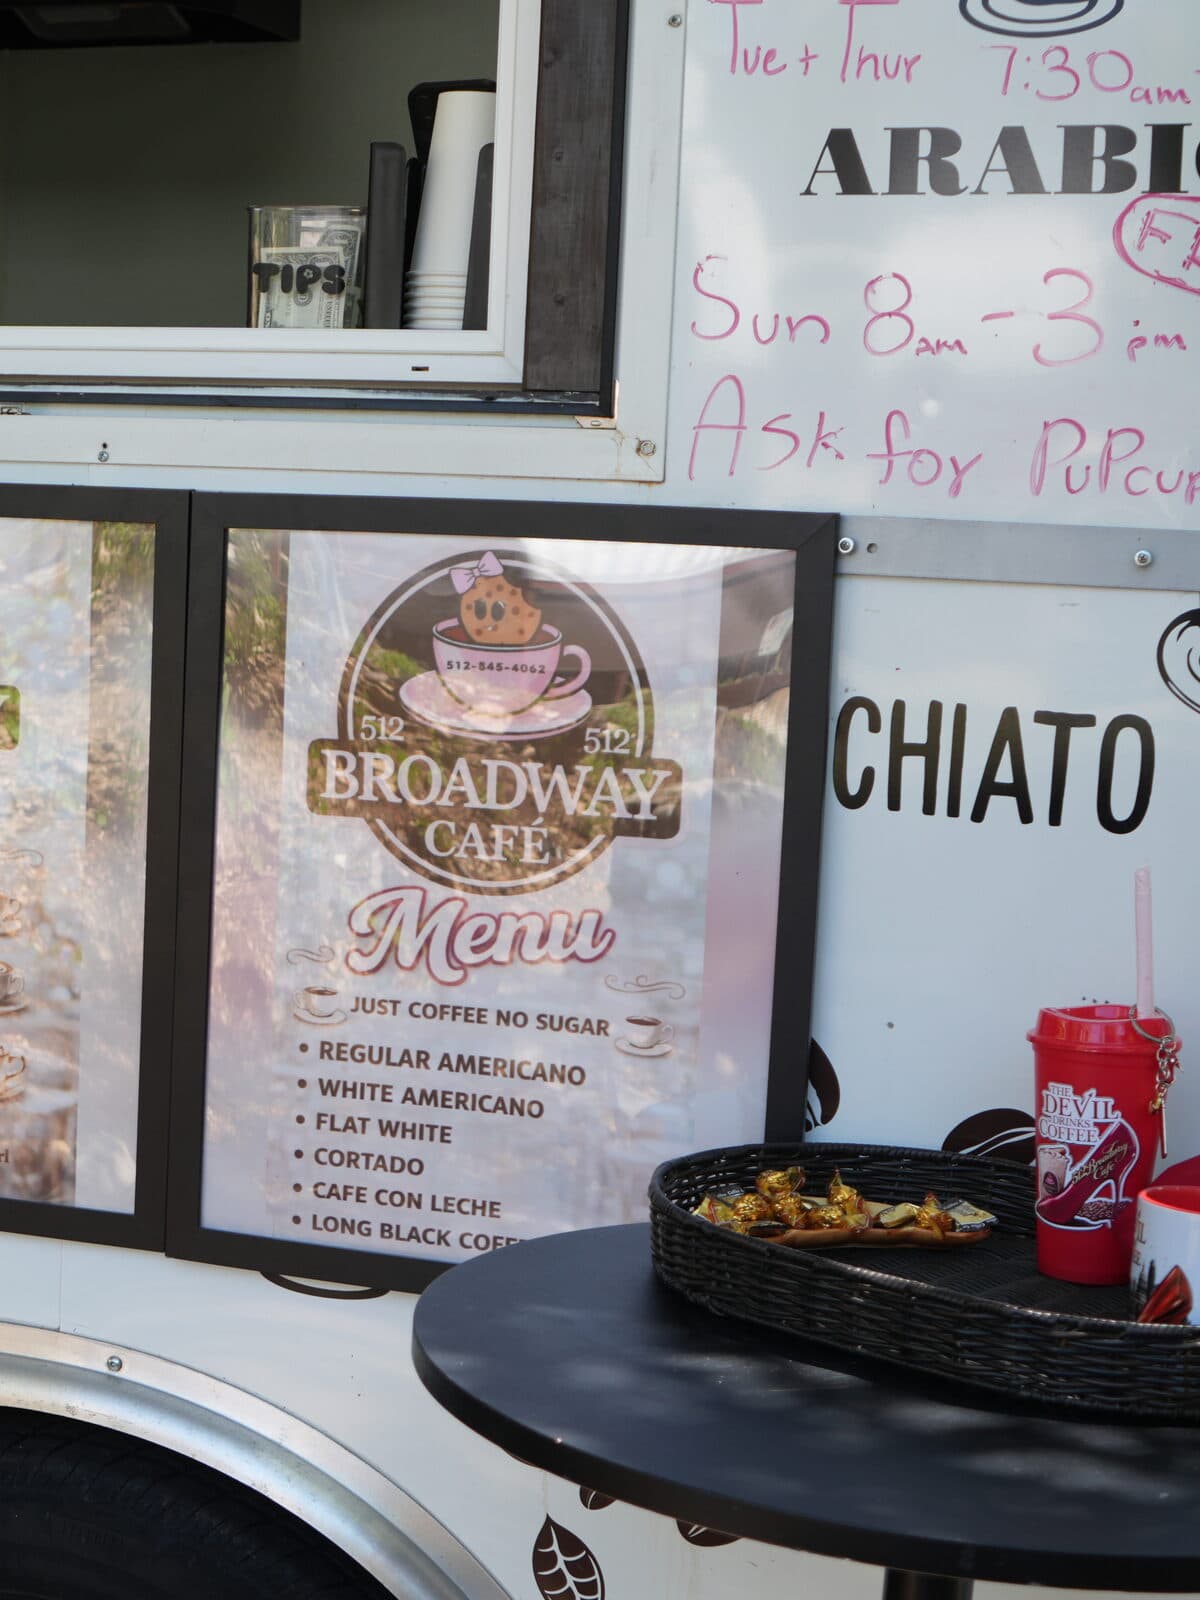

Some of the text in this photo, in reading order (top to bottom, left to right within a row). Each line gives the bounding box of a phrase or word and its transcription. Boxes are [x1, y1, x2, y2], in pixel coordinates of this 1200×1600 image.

[838, 0, 923, 83] Thur
[800, 123, 1200, 197] ARABI
[253, 262, 345, 295] TIPS
[690, 255, 832, 345] Sun
[688, 374, 847, 482] Ask
[865, 408, 983, 499] for
[360, 716, 405, 741] 512
[583, 727, 631, 754] 512
[320, 750, 673, 821] BROADWAY
[424, 818, 550, 864] CAFÉ
[345, 884, 616, 986] Menu
[350, 996, 611, 1038] JUST COFFEE NO SUGAR
[319, 1041, 586, 1086] REGULAR AMERICANO
[318, 1078, 545, 1119] WHITE AMERICANO
[1044, 1092, 1118, 1119] DEVIL
[1051, 1085, 1072, 1097] THE
[316, 1113, 452, 1144] FLAT WHITE
[1040, 1118, 1098, 1142] COFFEE
[1052, 1116, 1090, 1127] DRINKS
[314, 1148, 425, 1176] CORTADO
[313, 1181, 502, 1219] CAFE CON LECHE
[312, 1214, 372, 1238] LONG
[380, 1223, 451, 1247] BLACK
